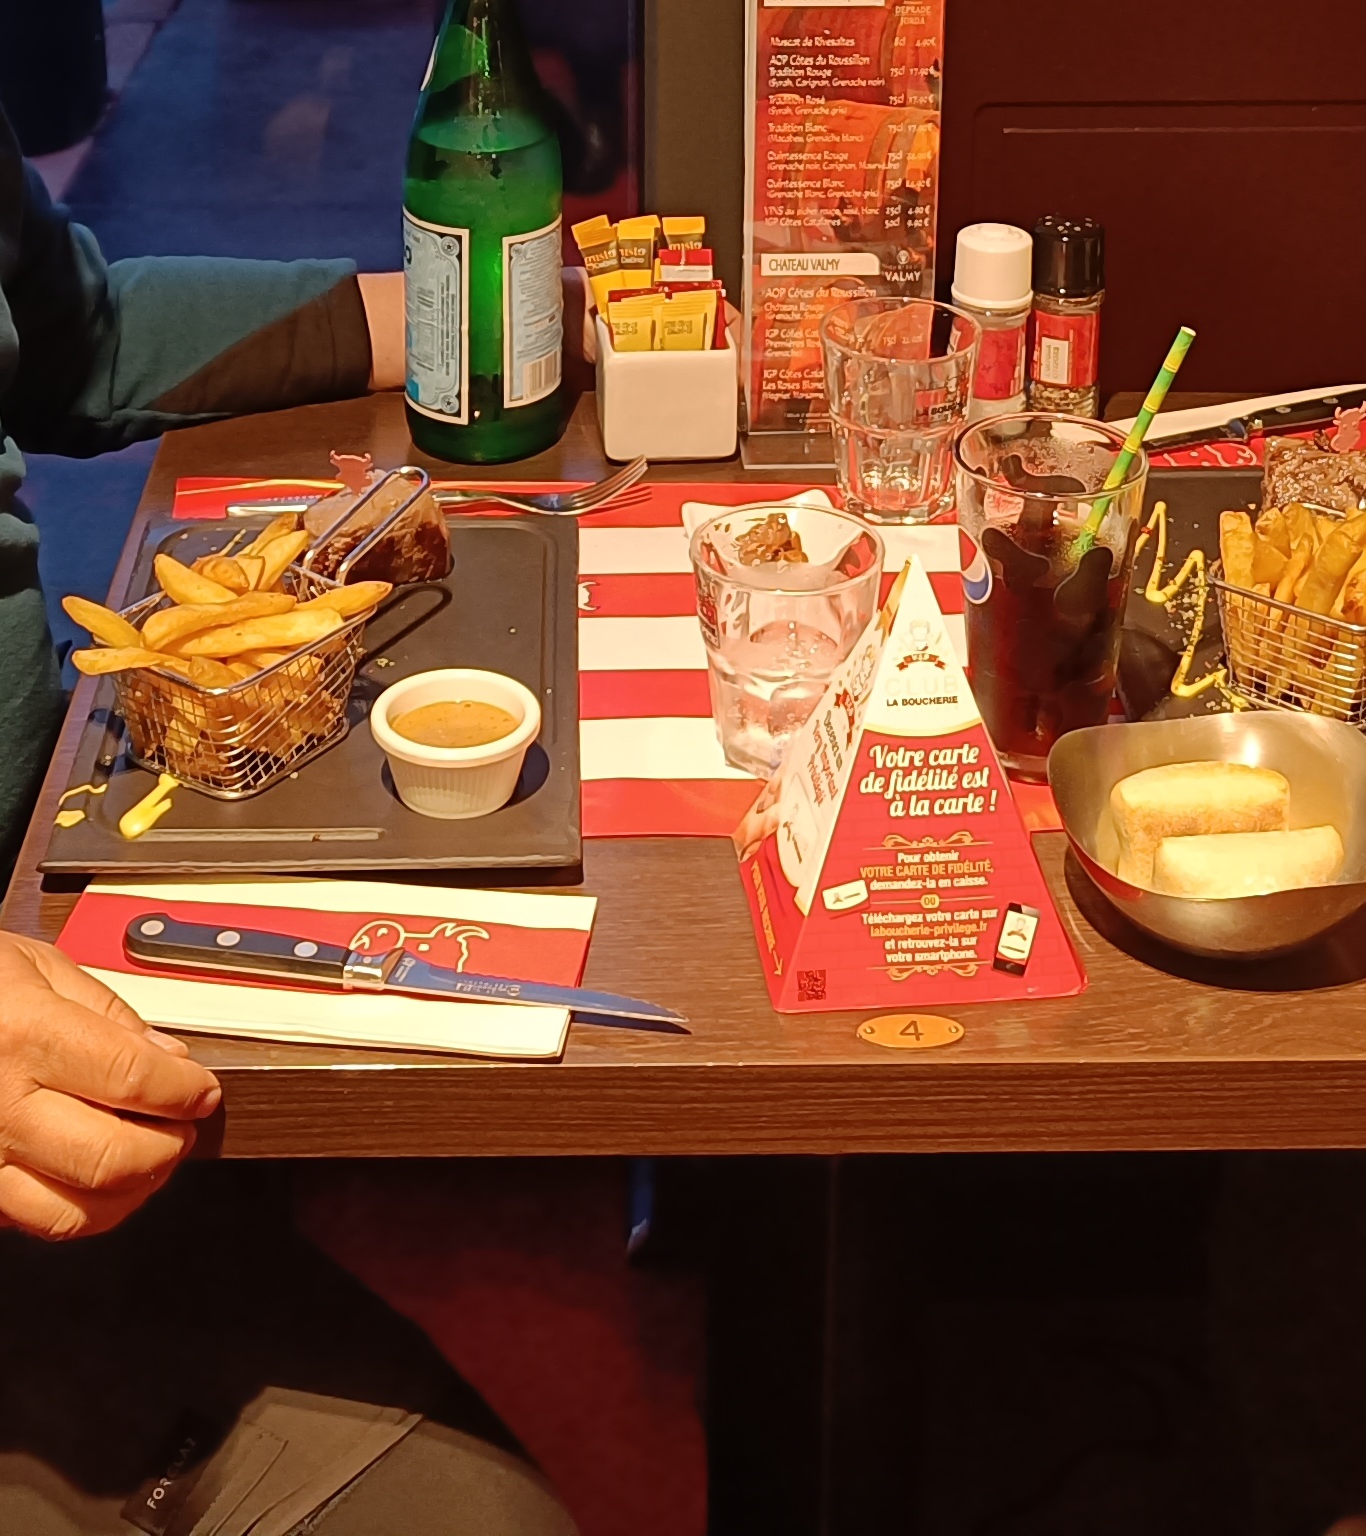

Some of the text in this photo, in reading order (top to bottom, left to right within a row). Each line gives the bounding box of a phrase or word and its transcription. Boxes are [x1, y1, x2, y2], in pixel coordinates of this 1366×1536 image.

[828, 54, 870, 65] Roussillon
[769, 67, 804, 76] Tradition
[806, 67, 832, 78] Rouge
[769, 258, 840, 271] CHATEAU VALMY
[885, 271, 921, 281] VALMY
[885, 675, 958, 697] CLUB
[902, 696, 958, 706] BOUCHERIE
[869, 743, 979, 768] Votre carte
[860, 766, 989, 799] de fidélité est
[890, 789, 997, 817] à la carte !
[898, 850, 959, 863] Pour obtenir
[860, 866, 894, 878] VOTRE
[896, 864, 929, 876] CARTE
[932, 864, 945, 874] DE
[870, 877, 936, 890] demandez-la
[938, 878, 951, 888] en
[923, 896, 936, 905] OU
[861, 909, 998, 925] Téléchargez votre carte sur
[884, 936, 977, 950] et retrouvez-la sur
[886, 952, 912, 962] votre
[899, 1020, 924, 1041] 4
